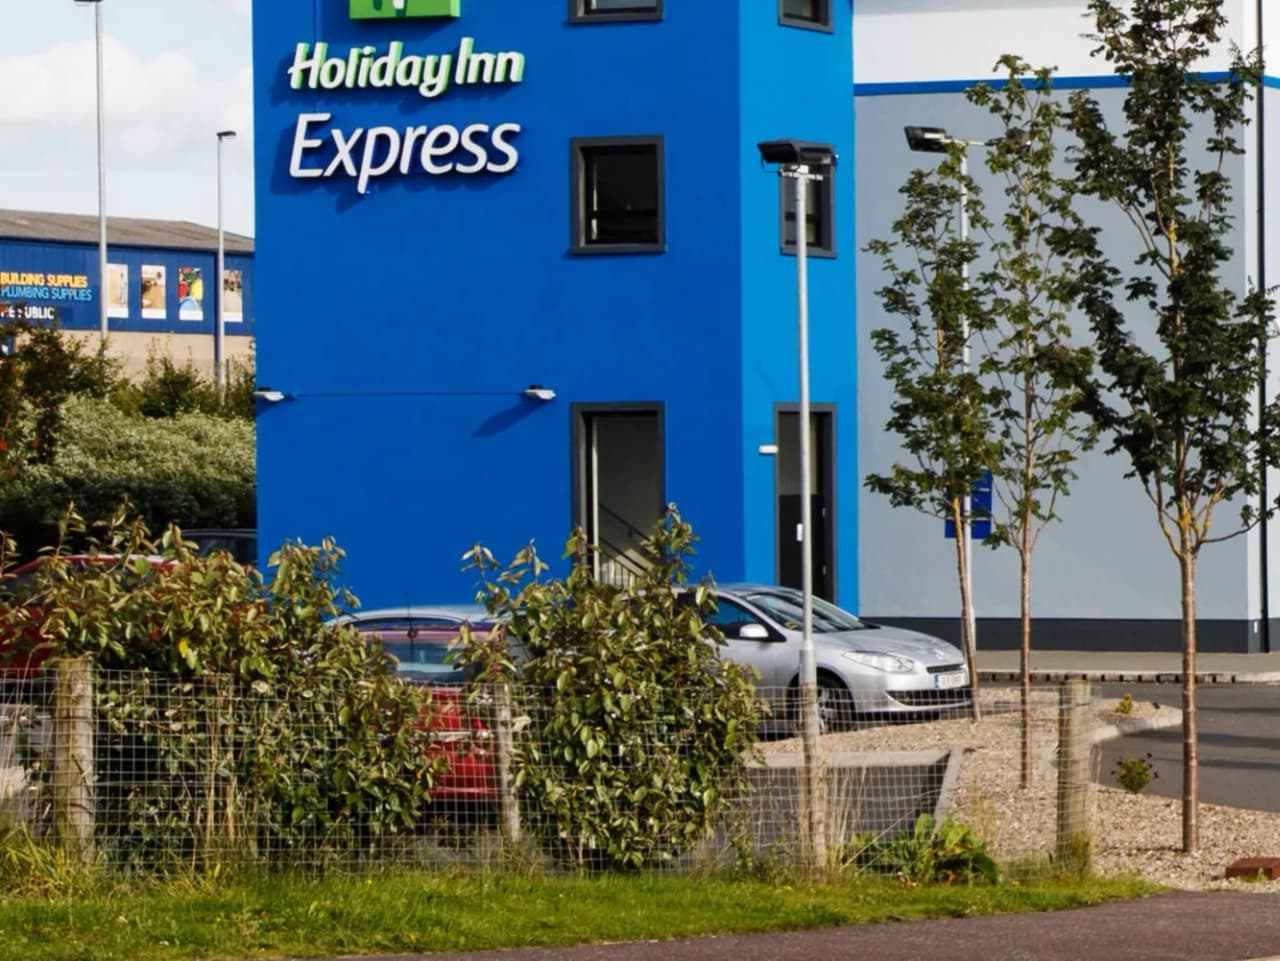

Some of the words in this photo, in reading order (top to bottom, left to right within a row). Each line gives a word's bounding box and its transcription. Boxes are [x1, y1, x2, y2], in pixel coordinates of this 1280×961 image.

[287, 41, 450, 97] Holiday
[455, 37, 525, 85] Inn
[289, 112, 521, 194] Express
[0, 272, 44, 286] BUILDING
[47, 274, 88, 288] SUPPLIES
[1, 286, 49, 300] PLUMBING
[51, 288, 92, 301] SUPPLIES
